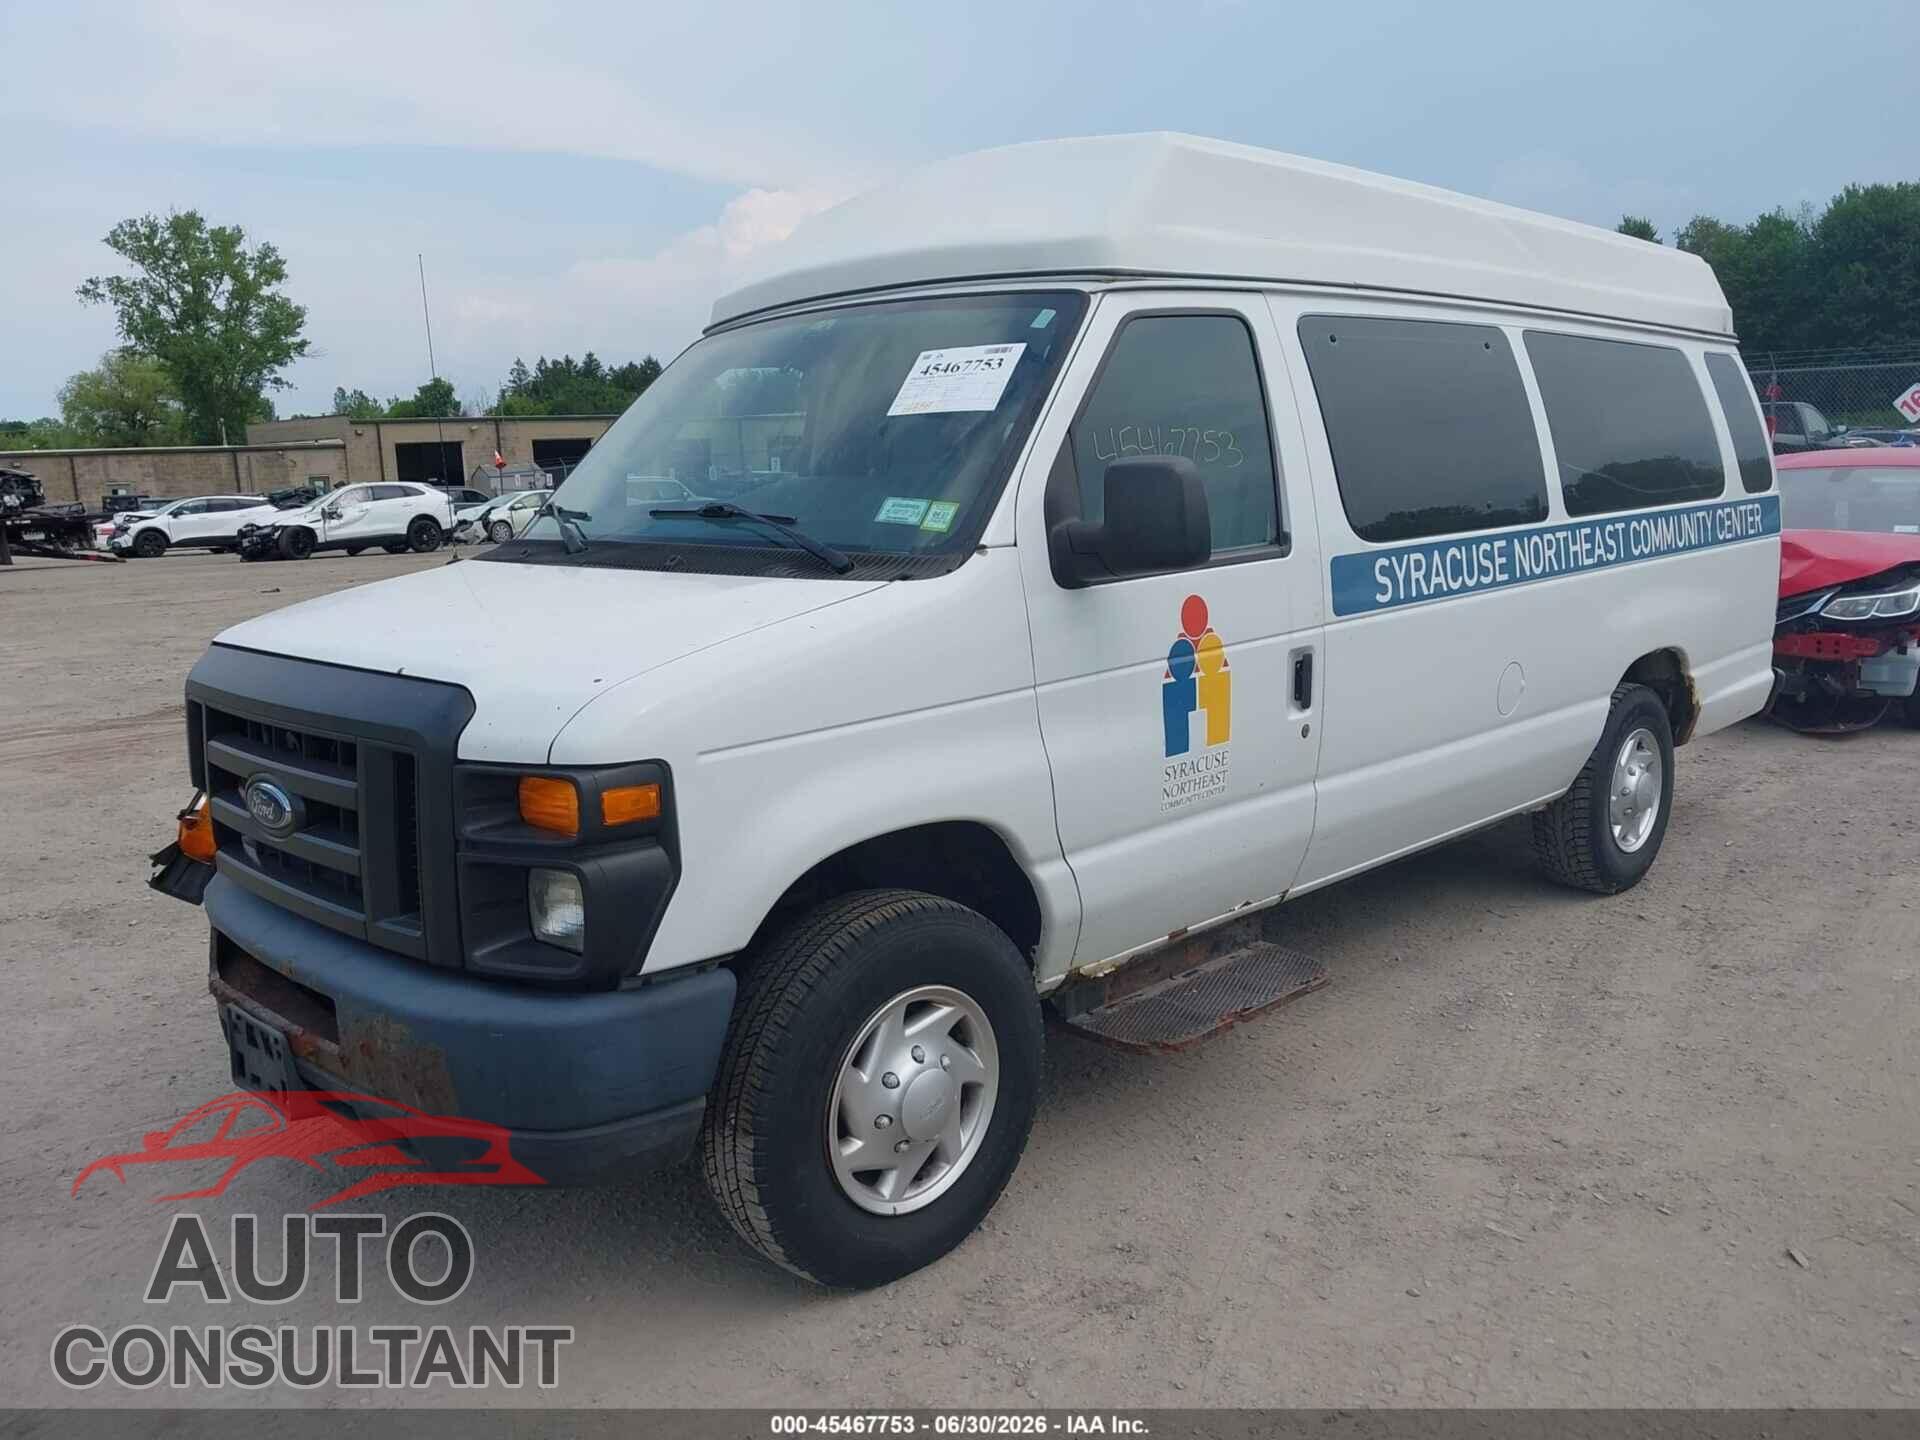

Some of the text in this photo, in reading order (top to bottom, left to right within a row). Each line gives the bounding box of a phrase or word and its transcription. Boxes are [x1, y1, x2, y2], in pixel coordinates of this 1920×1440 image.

[920, 358, 1004, 376] 45467753
[1374, 503, 1763, 603] SYRACUSE NORTHEAST COMMUNITY CENTER
[1164, 750, 1229, 782] SYRACUSE
[1162, 769, 1228, 801] NORTHEAST
